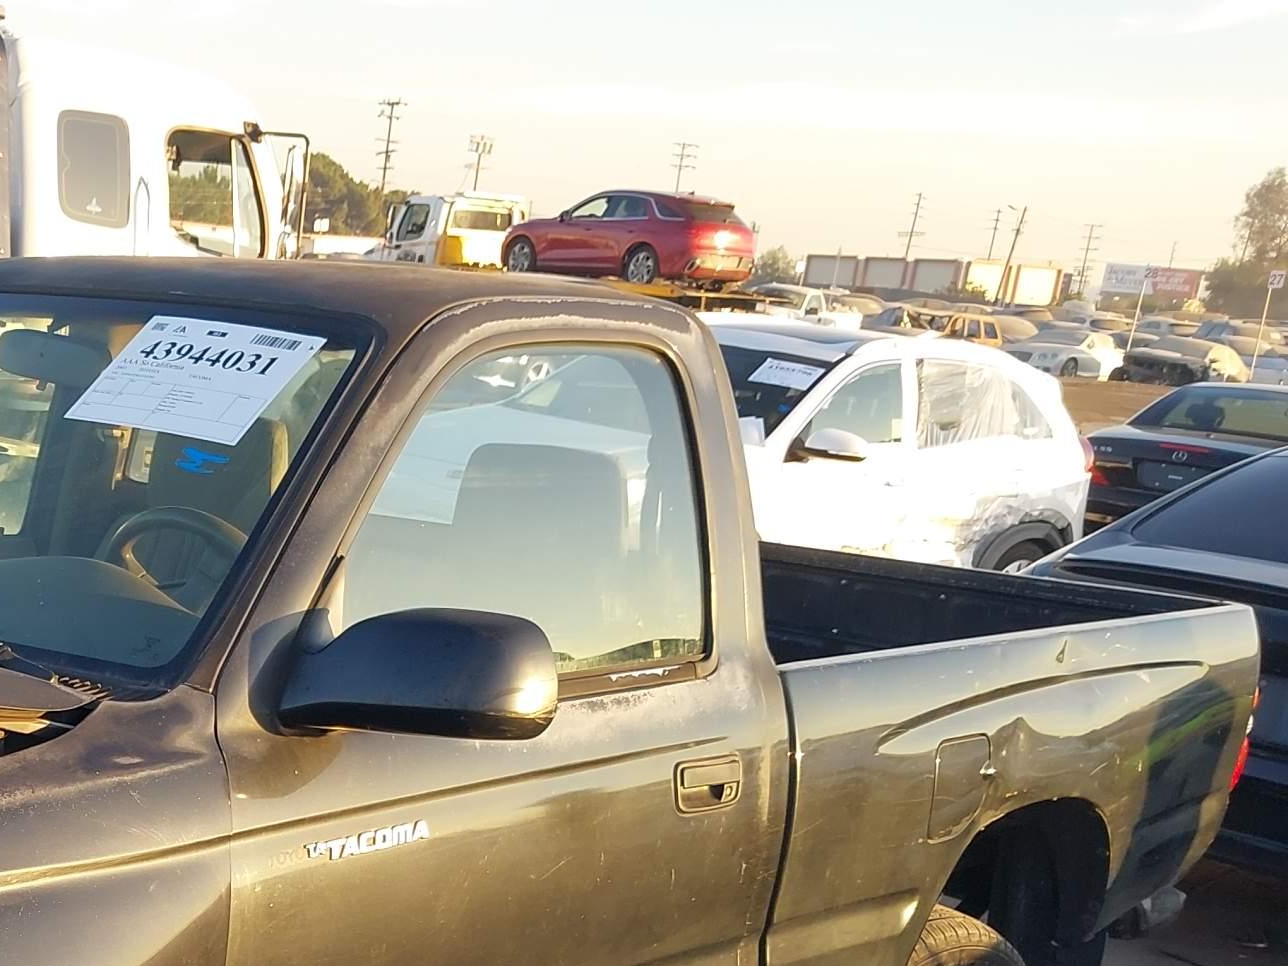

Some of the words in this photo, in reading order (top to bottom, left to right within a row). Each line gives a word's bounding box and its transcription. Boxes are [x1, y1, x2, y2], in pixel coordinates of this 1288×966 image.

[1144, 267, 1159, 279] 28
[1269, 272, 1285, 286] 27
[139, 339, 281, 378] 43944031
[327, 819, 431, 861] TACOMA
